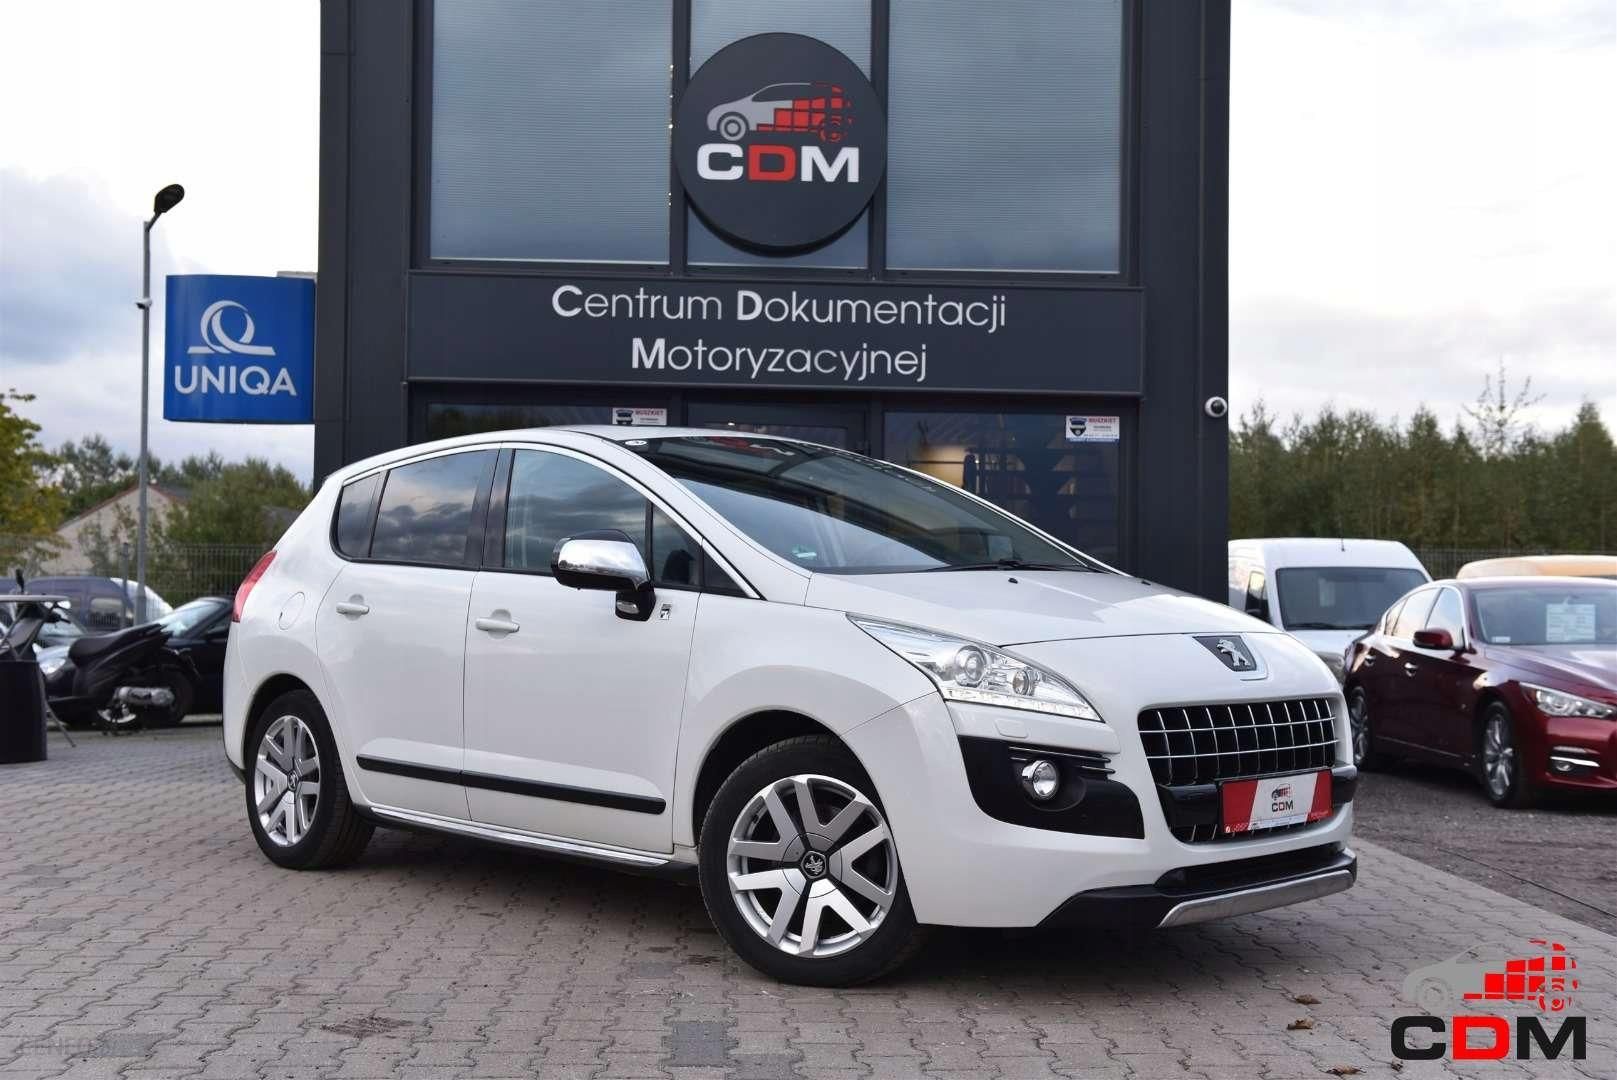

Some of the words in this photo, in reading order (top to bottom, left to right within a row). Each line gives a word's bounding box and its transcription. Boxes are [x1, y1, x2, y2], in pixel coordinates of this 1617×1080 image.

[697, 143, 859, 183] CDM
[552, 285, 722, 320] Centrum
[737, 289, 1005, 333] Dokumentacji
[632, 337, 926, 382] Motoryzacyjnej
[174, 365, 297, 396] UNIQA
[1271, 800, 1294, 813] CDM
